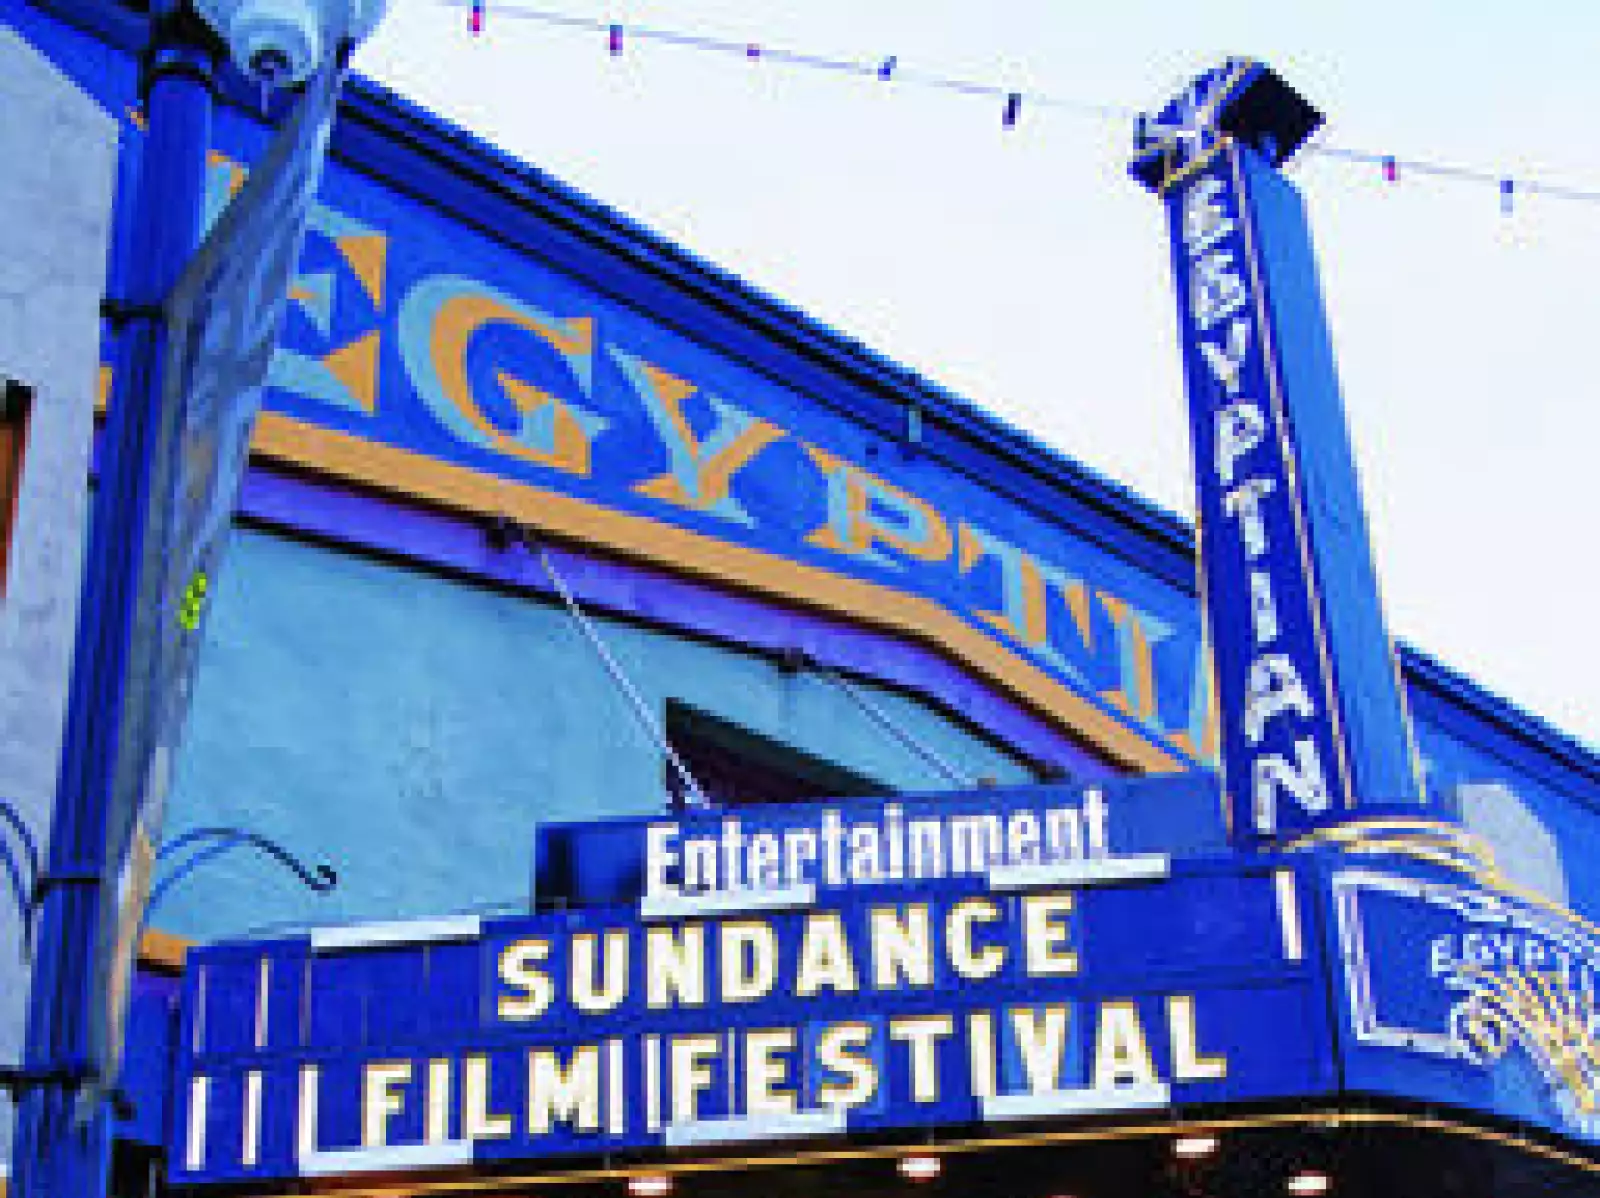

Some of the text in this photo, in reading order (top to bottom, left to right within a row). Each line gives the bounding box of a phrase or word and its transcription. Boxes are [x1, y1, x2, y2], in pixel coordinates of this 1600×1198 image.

[646, 788, 1108, 898] Entertainment
[497, 894, 1079, 1020] SUNDANCE
[361, 994, 1228, 1147] FILM FESTIVAL
